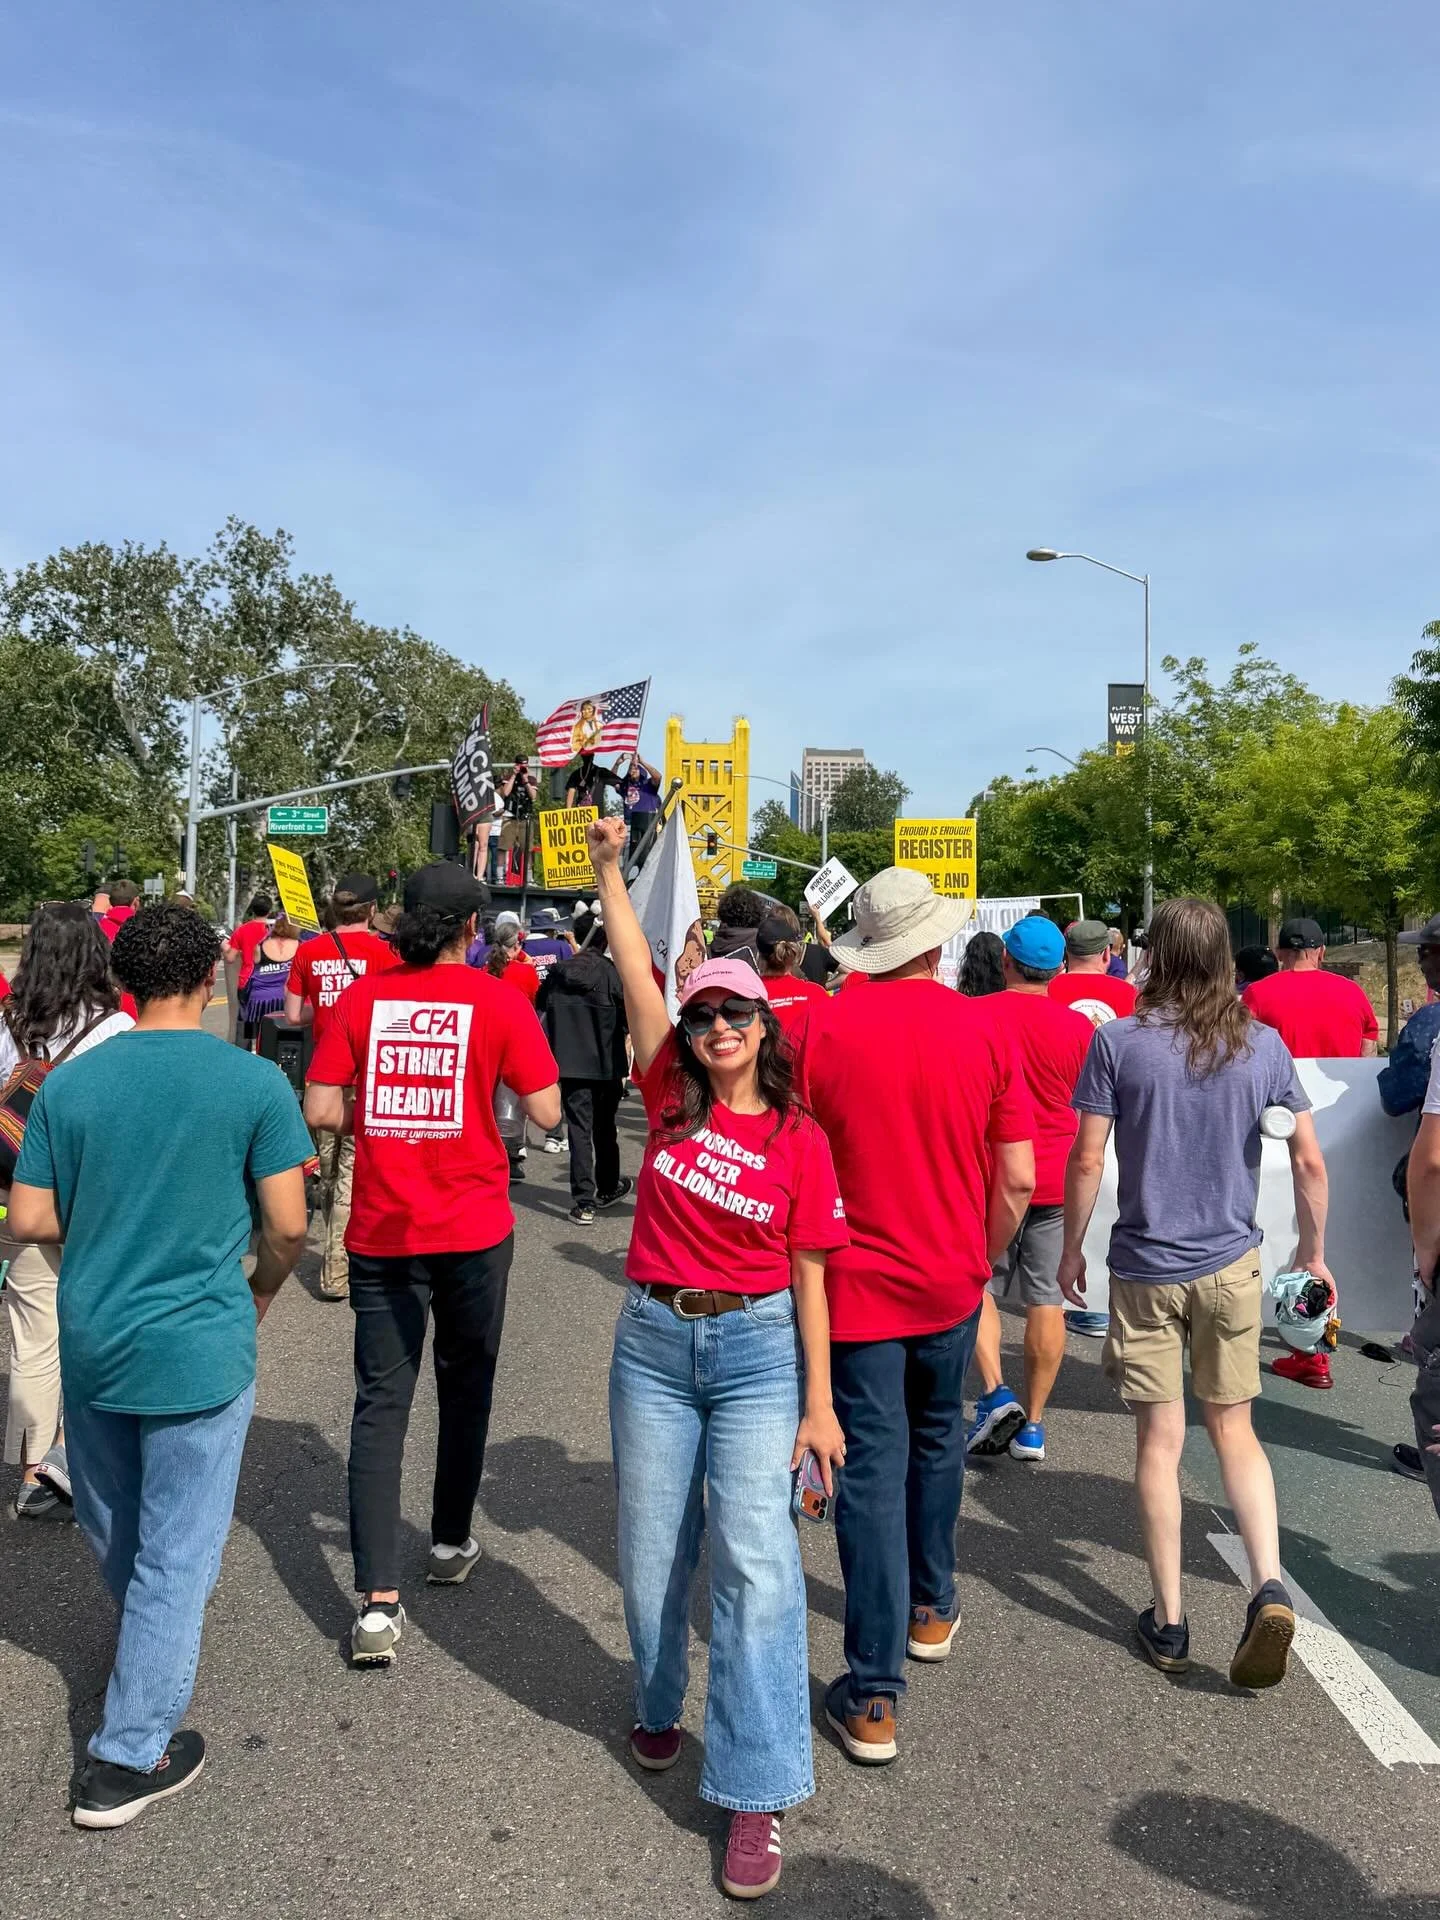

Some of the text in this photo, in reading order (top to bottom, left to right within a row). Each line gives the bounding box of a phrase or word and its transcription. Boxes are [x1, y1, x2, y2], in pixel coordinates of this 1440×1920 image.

[1110, 713, 1142, 725] WEST
[1115, 725, 1136, 735] WAY
[270, 822, 306, 831] Riverfront
[544, 809, 593, 827] NO WARS
[548, 828, 567, 848] NO
[899, 826, 972, 836] ENOUGH IS ENOUGH!
[899, 838, 973, 859] REGISTER
[557, 850, 586, 866] NO
[547, 865, 594, 879] BILLIONAIRE
[810, 867, 832, 891] WORKERS
[819, 879, 833, 893] OVER
[944, 873, 969, 889] AND
[321, 976, 333, 991] IS
[409, 1008, 459, 1037] CFA
[379, 1045, 456, 1077] STRIKE
[376, 1085, 453, 1117] READY!
[364, 1128, 463, 1140] FUND THE UNIVERSITY!
[691, 1128, 767, 1171] WORKERS
[696, 1151, 741, 1186] OVER
[653, 1150, 774, 1224] BILLIONAIRES!
